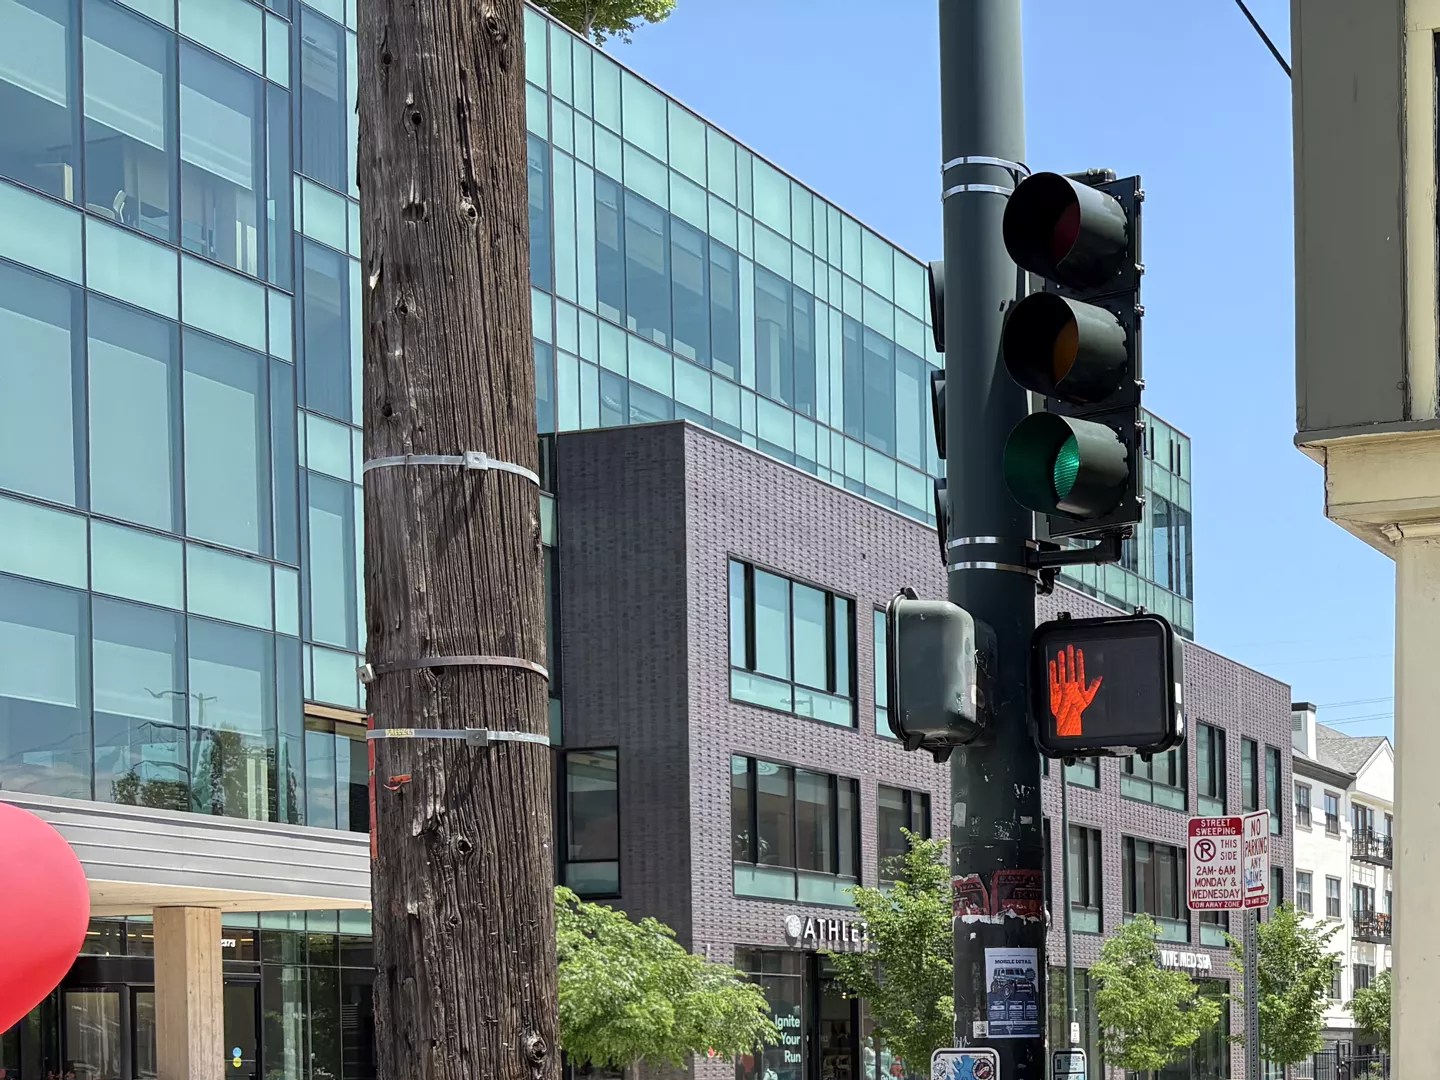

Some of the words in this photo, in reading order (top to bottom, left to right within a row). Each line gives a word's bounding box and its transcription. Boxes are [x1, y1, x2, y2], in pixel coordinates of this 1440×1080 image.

[1196, 827, 1236, 835] SWEEPING
[1250, 818, 1260, 837] NO
[1221, 840, 1237, 848] THIS
[1245, 837, 1267, 857] PARKING
[1220, 851, 1237, 860] SIDE
[1251, 858, 1260, 869] ANY
[1195, 878, 1227, 887] MONDAY
[1231, 877, 1236, 886] &
[1250, 870, 1262, 882] TIME
[1192, 889, 1240, 899] WEDNESDAY
[1180, 952, 1196, 968] MED
[775, 1014, 800, 1030] Ignite
[780, 1031, 800, 1045] Your
[784, 1050, 801, 1063] Run
